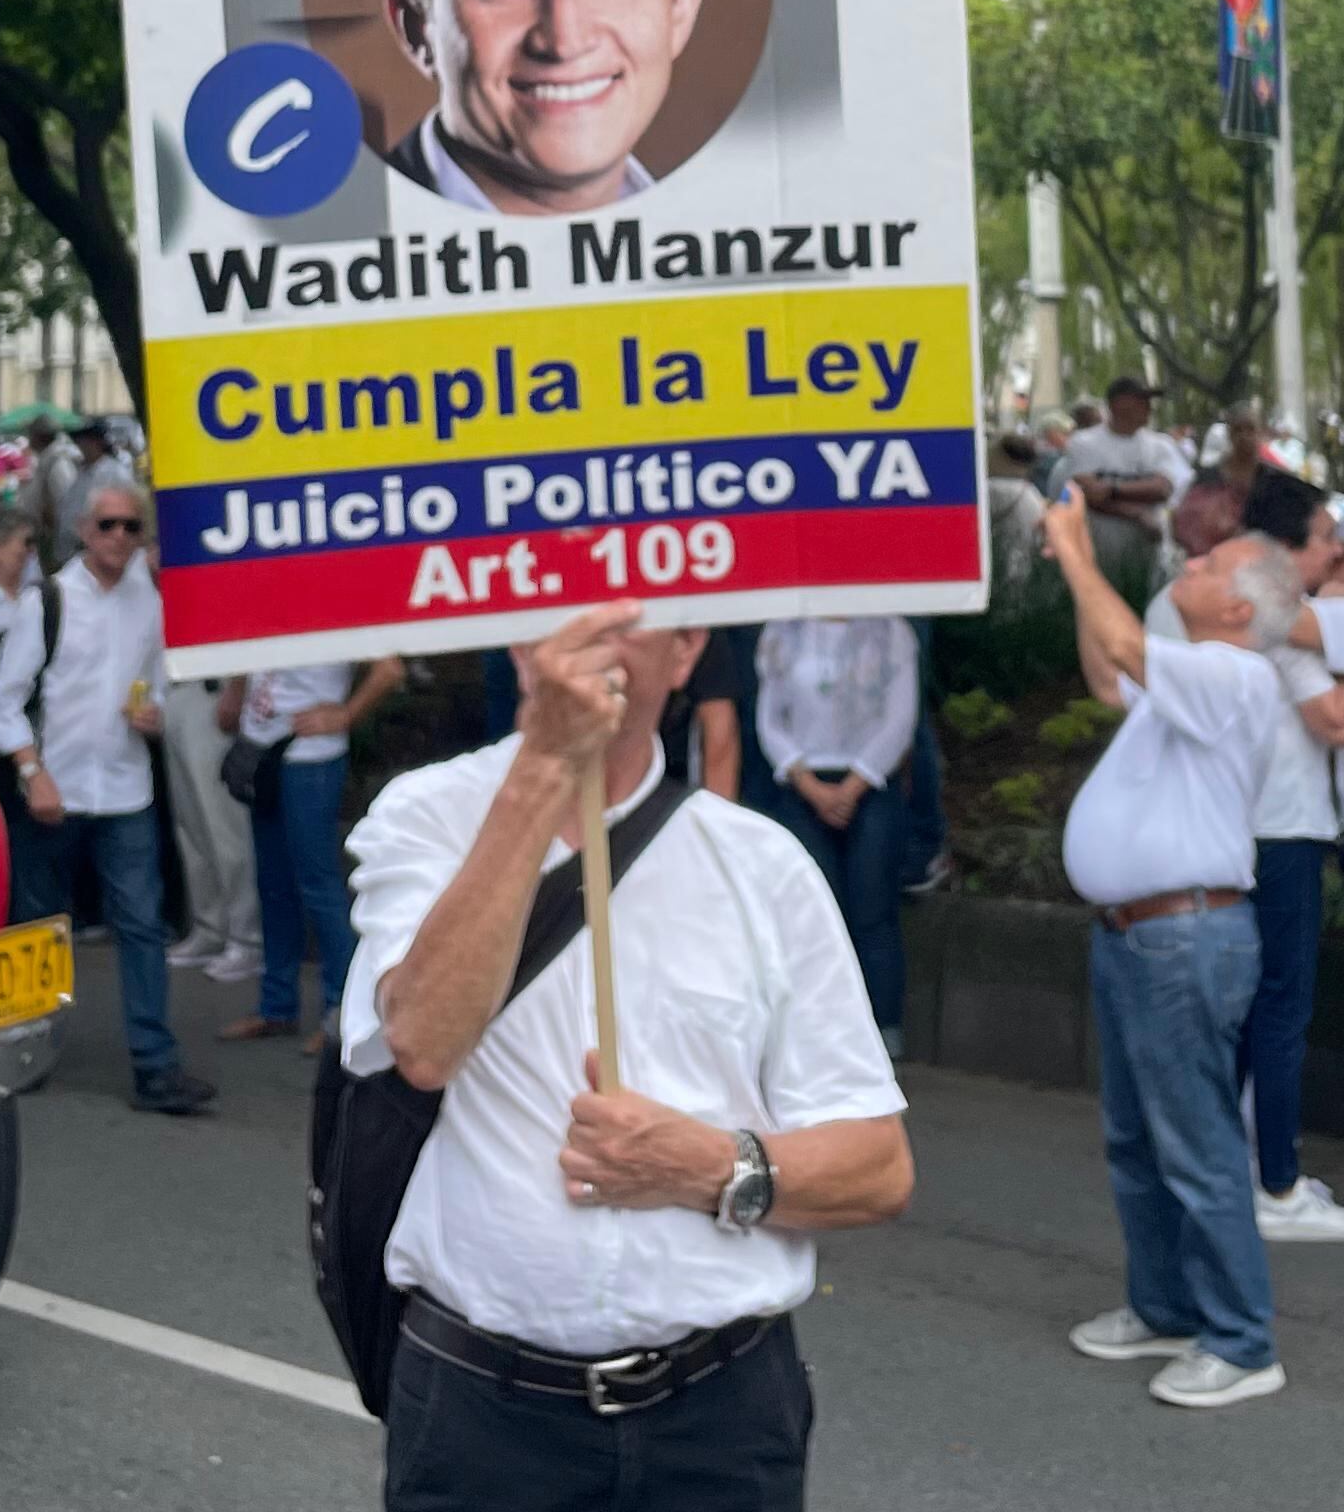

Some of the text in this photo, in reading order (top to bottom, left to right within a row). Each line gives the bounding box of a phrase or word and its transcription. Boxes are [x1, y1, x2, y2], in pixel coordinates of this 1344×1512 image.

[190, 219, 917, 315] Wadith Manzur
[197, 328, 919, 440] Cumpla la Ley
[202, 441, 929, 555] Juicio Político YA
[410, 525, 733, 607] Art. 109
